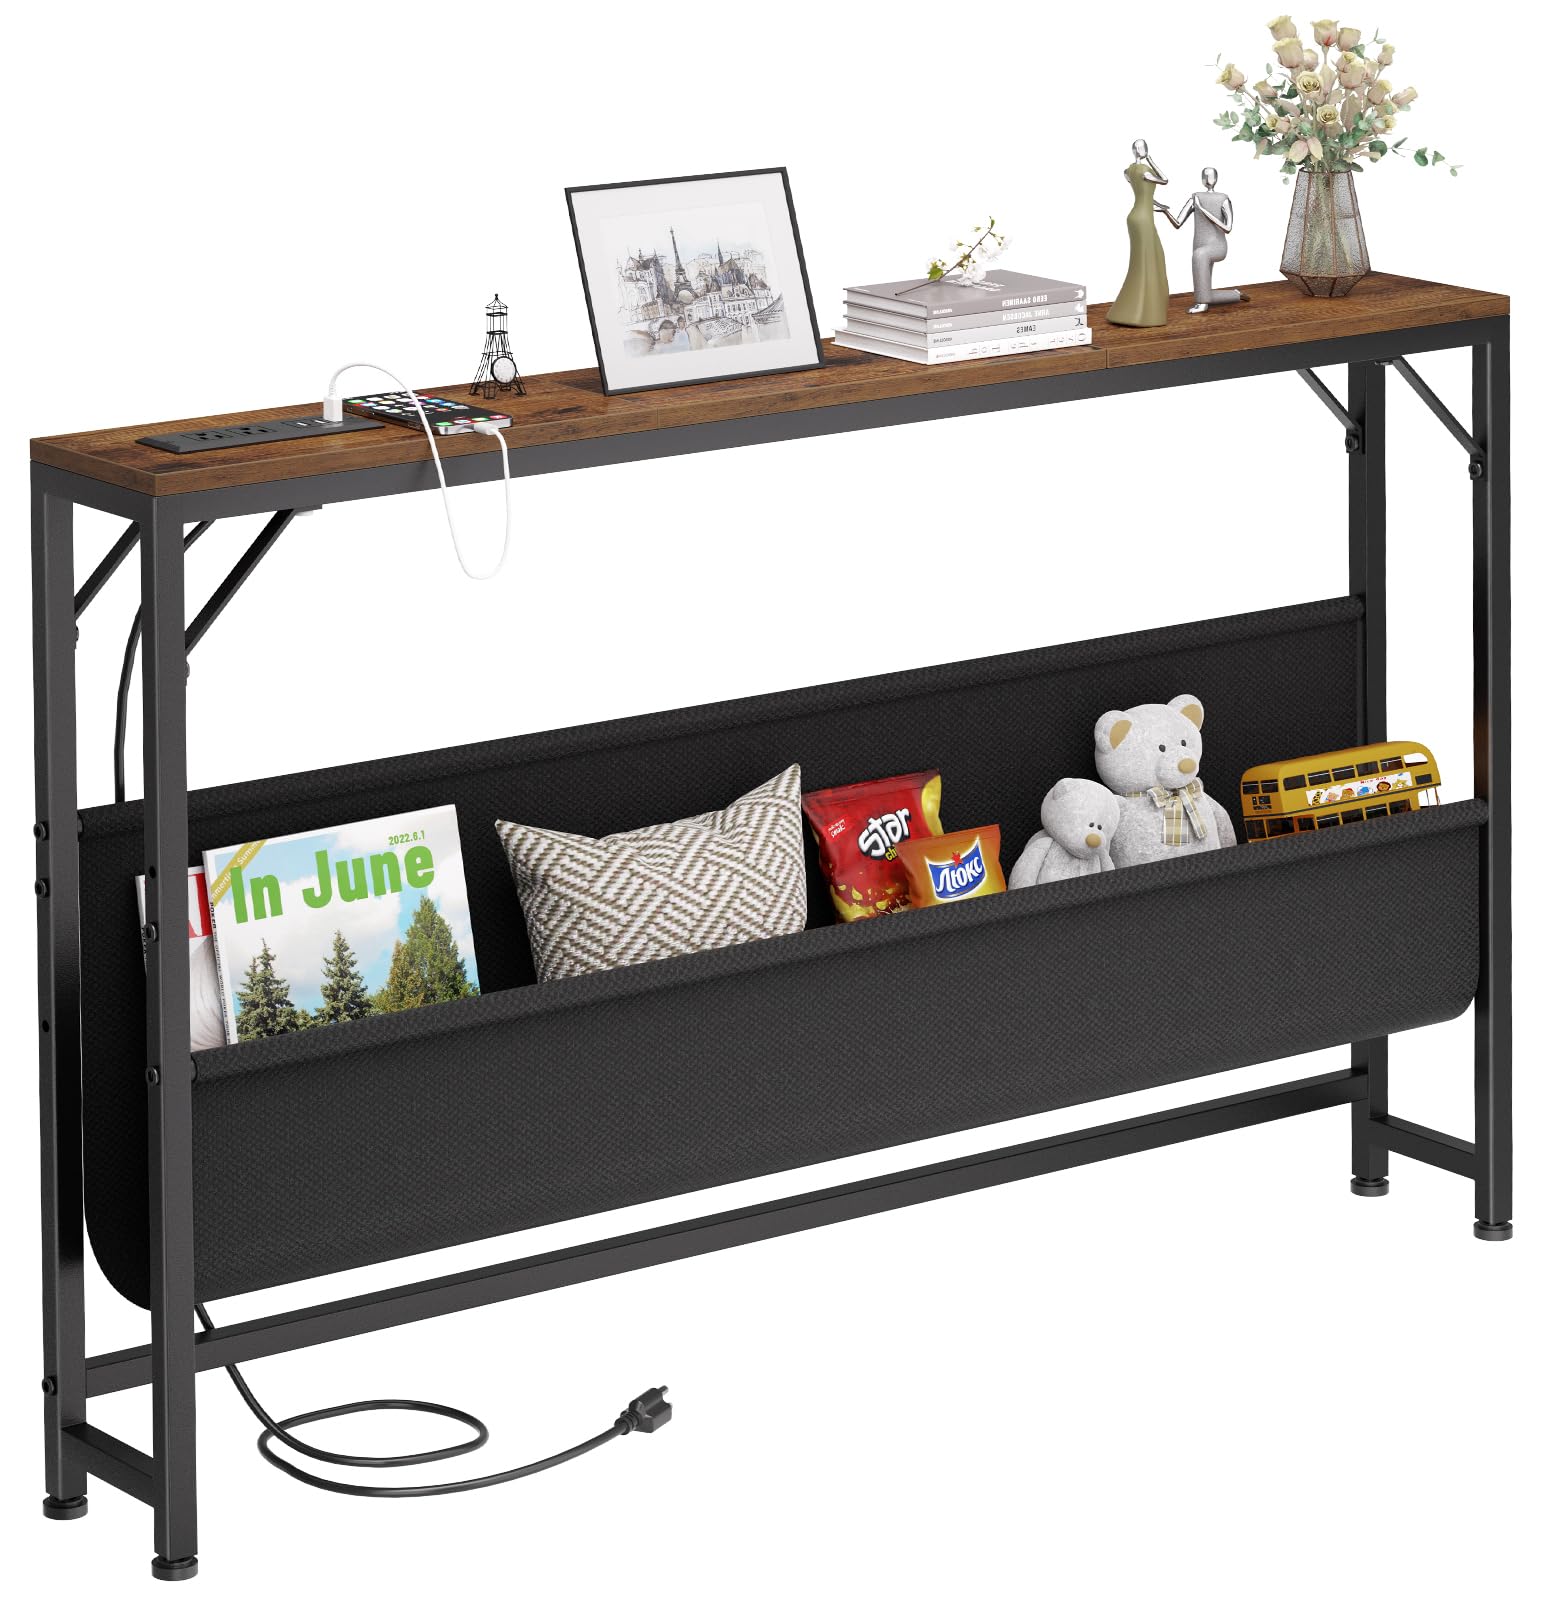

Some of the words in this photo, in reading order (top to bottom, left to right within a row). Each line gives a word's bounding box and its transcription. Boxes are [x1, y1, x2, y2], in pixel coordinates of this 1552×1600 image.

[388, 830, 425, 846] 2022.6.1
[231, 866, 283, 924] In
[302, 845, 435, 909] June
